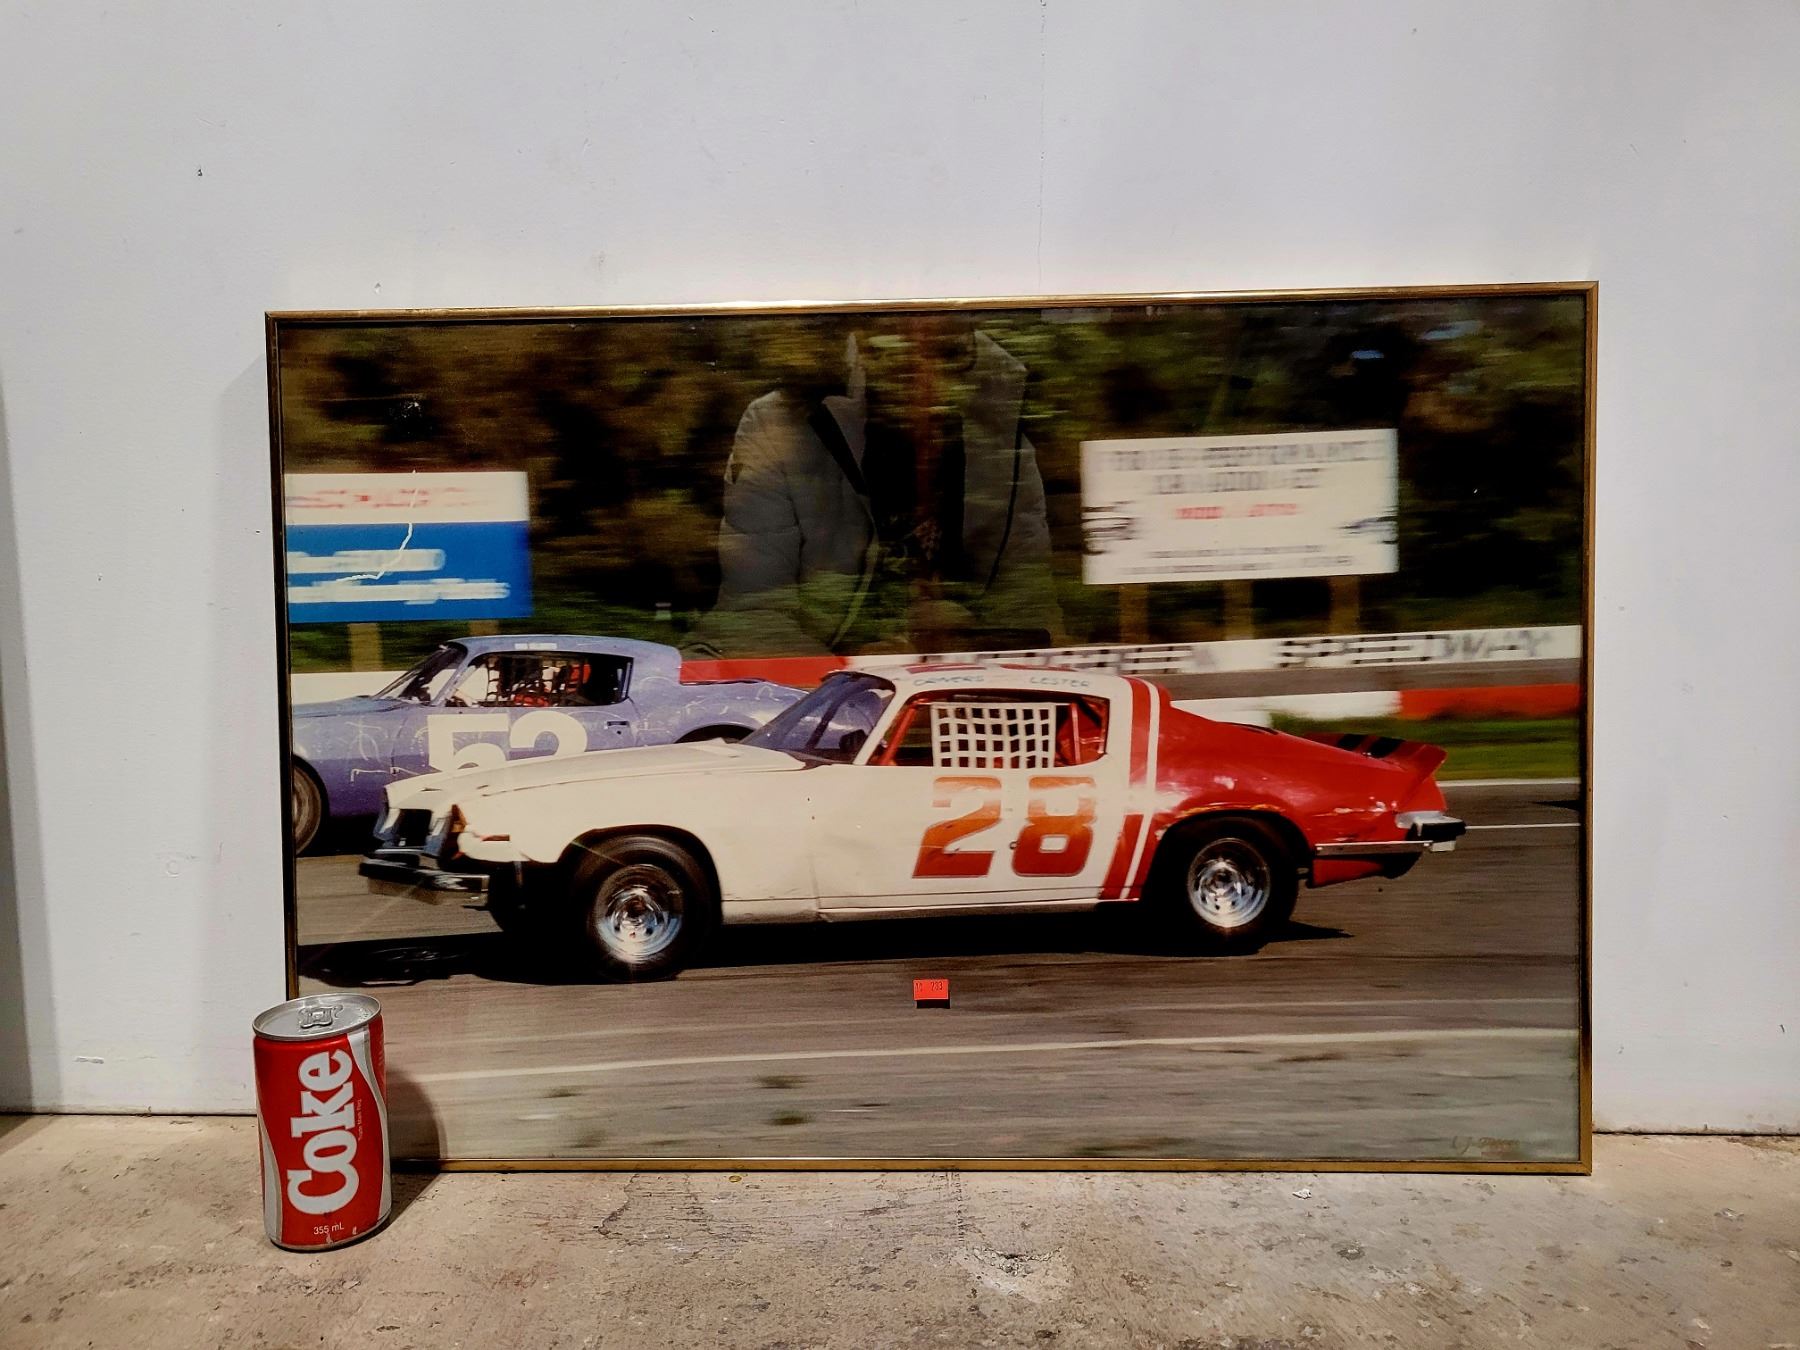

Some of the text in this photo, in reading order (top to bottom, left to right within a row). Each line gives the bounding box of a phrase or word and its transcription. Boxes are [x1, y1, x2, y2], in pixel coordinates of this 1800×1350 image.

[911, 776, 1097, 879] 28
[287, 1049, 359, 1215] Coke
[313, 1225, 330, 1235] 355
[331, 1221, 344, 1232] mL
